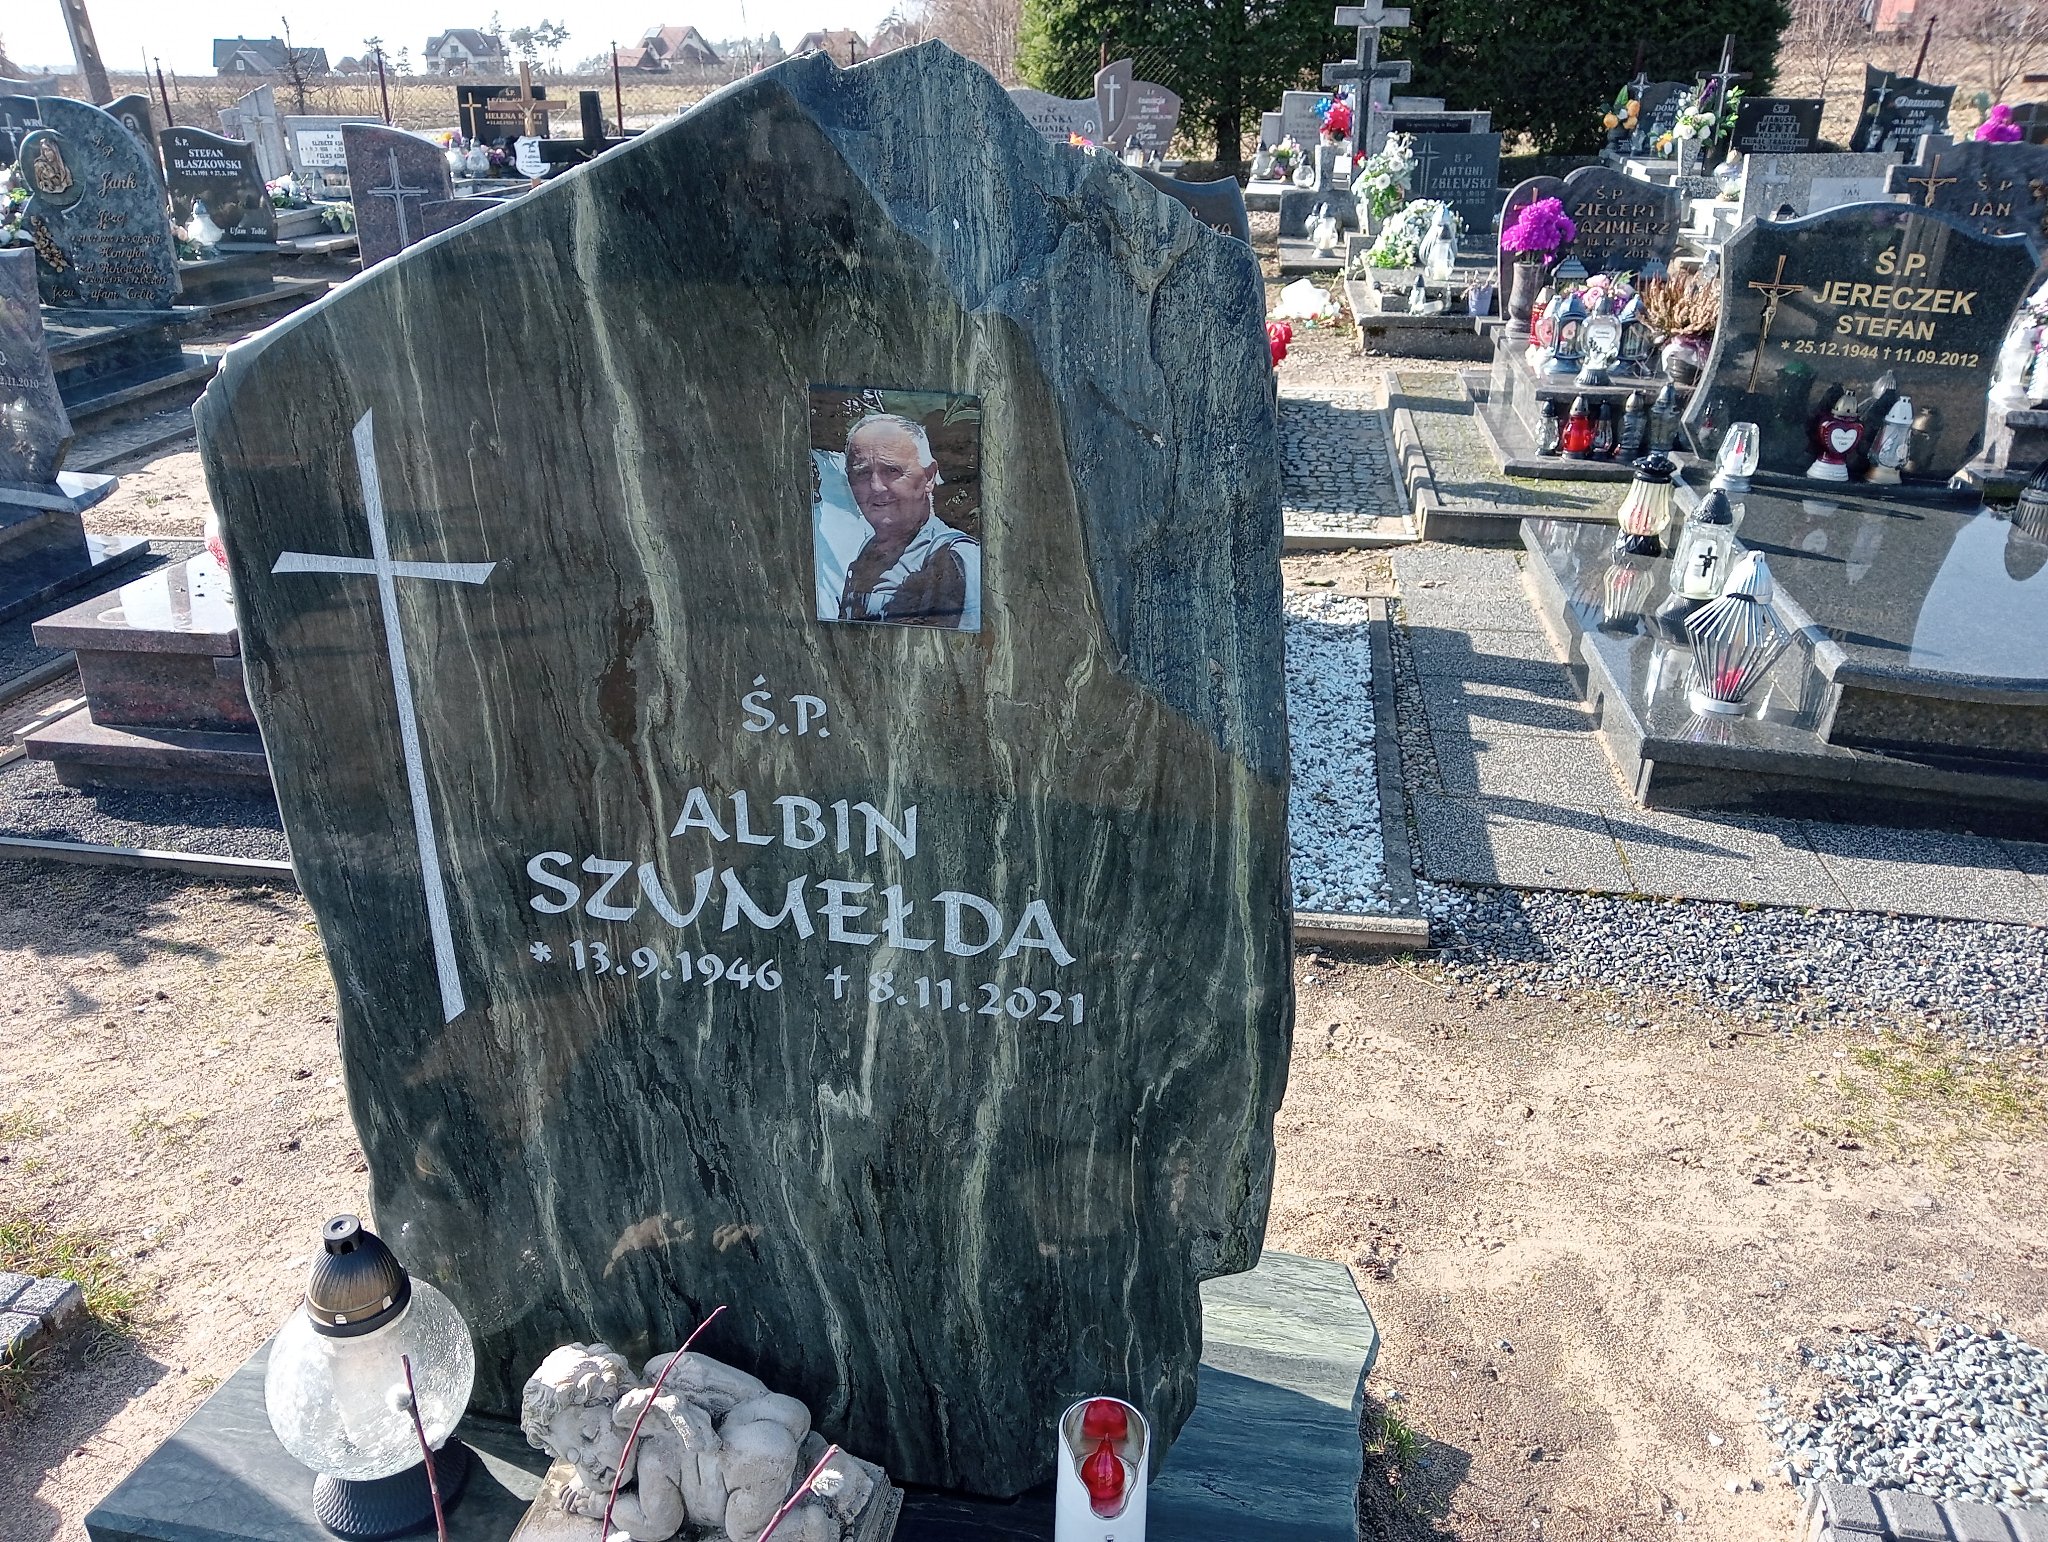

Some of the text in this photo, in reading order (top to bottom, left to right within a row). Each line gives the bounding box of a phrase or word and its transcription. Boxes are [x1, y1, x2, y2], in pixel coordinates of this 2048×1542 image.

[1756, 122, 1800, 134] WENTA
[188, 149, 224, 157] STEFAN
[1442, 166, 1483, 176] ANTONI
[1574, 203, 1656, 217] ZIEGERT
[1969, 202, 2012, 217] JAN
[1876, 246, 1927, 277] Ś.P.
[1812, 281, 1978, 315] JERECZEK
[1836, 315, 1936, 341] STEFAN
[1794, 340, 1979, 368] 25.12.1944 11.09.2012
[741, 674, 831, 738] Ś.P.
[670, 786, 918, 859] ALBIN
[526, 851, 1077, 966] SZUMEŁDA
[570, 940, 1085, 1024] 13.9.1946 8.11.2021
